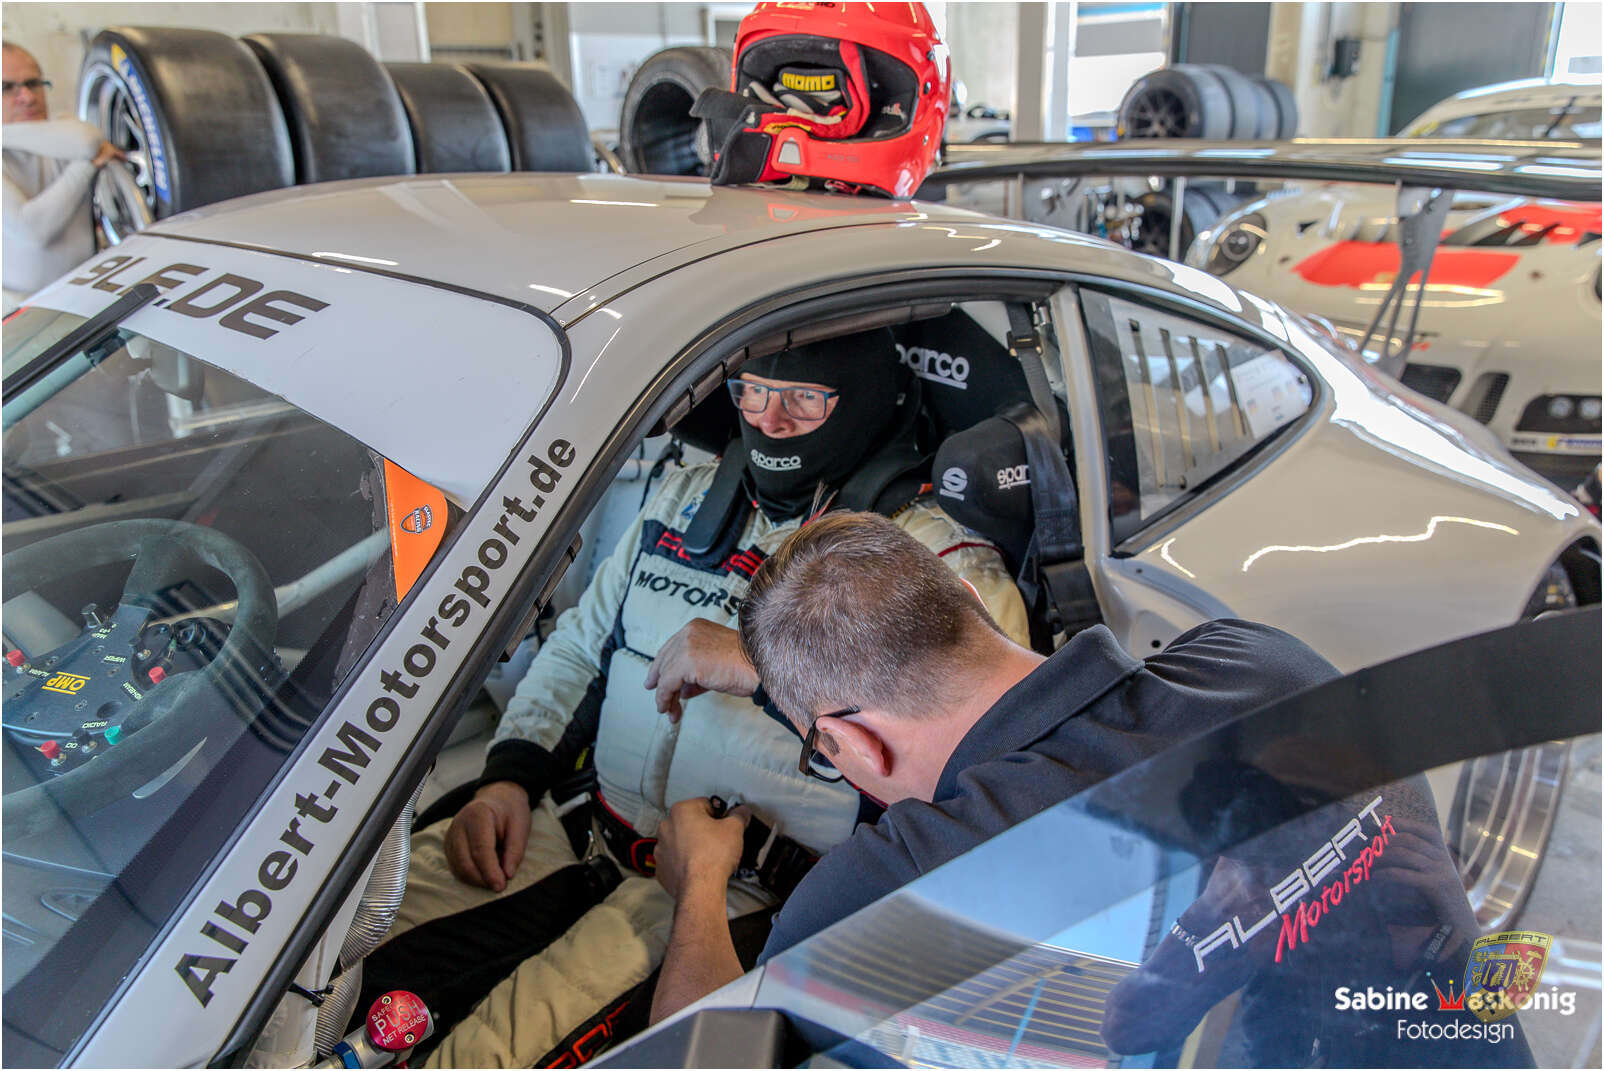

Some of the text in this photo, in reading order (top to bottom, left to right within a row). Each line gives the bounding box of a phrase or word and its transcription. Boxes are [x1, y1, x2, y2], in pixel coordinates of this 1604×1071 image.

[750, 449, 801, 471] sparco
[45, 675, 86, 692] OMP
[81, 720, 108, 729] RADIO
[173, 436, 578, 1009] Albert-Motorsport.de
[1193, 796, 1383, 973] ALBERT
[1275, 814, 1396, 963] Motorsport
[375, 1000, 422, 1037] PUSH
[382, 1014, 426, 1046] NET RELEASE
